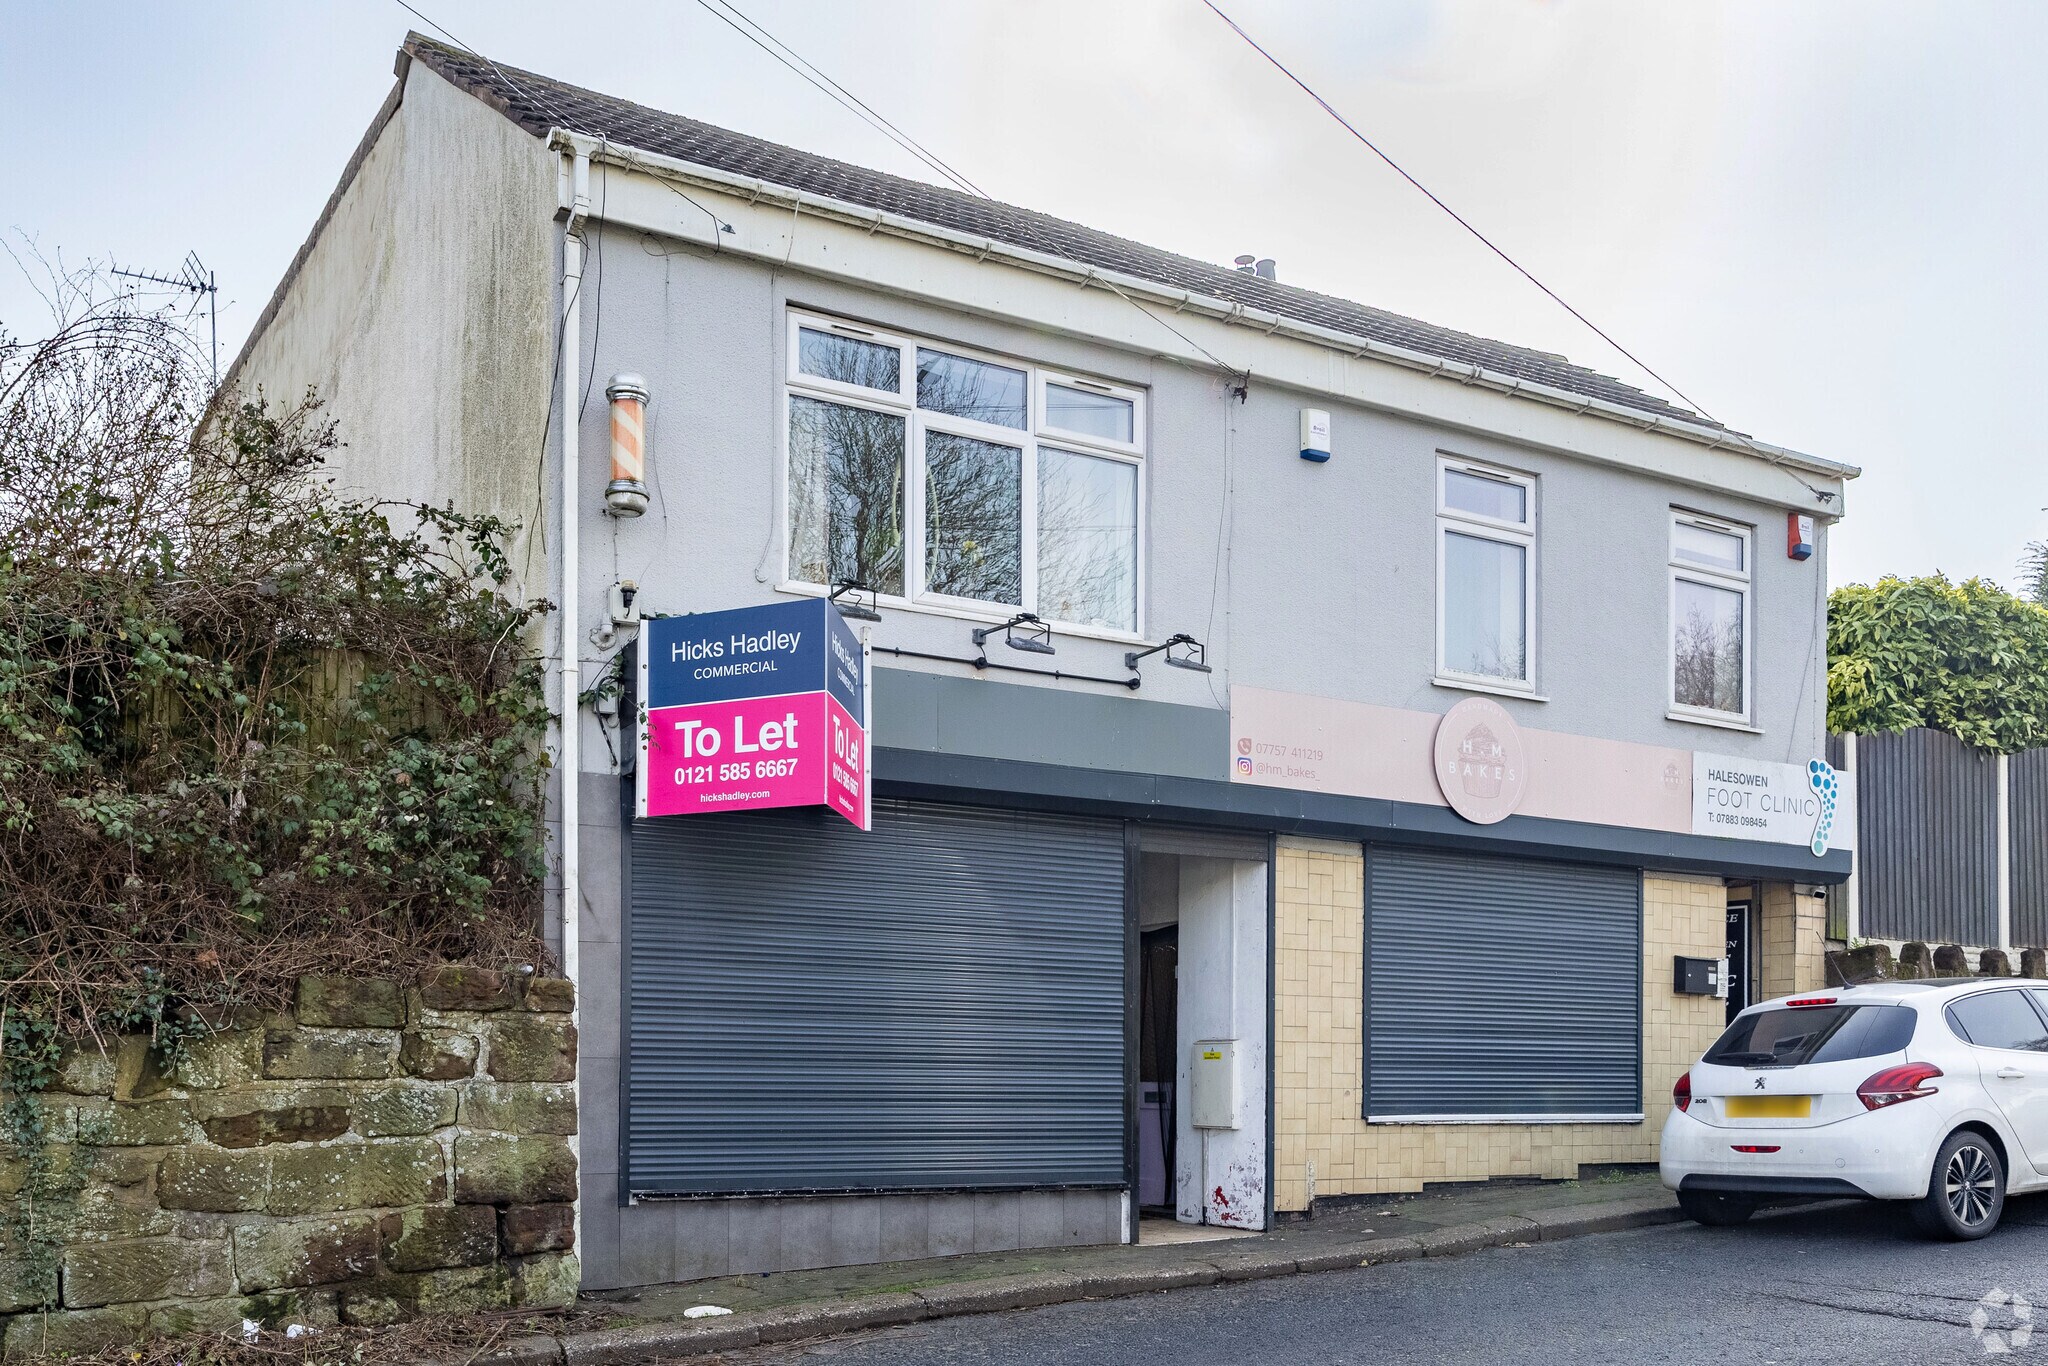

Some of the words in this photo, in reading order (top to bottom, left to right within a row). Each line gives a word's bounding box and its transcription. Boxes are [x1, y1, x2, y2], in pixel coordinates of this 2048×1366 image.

[672, 637, 724, 663] Hicks
[731, 630, 801, 655] Hadley
[832, 631, 845, 664] Hicks
[693, 660, 778, 680] COMMERCIAL
[675, 720, 722, 758] To
[735, 712, 799, 754] Let
[832, 714, 844, 758] To
[846, 727, 859, 774] Let
[1255, 743, 1287, 756] 07757
[1291, 747, 1324, 761] 411219
[674, 765, 713, 785] 0121
[719, 762, 751, 781] 585
[755, 758, 799, 779] 6667
[1448, 761, 1516, 782] BAKES
[1708, 769, 1768, 788] HALESOWEN
[700, 790, 771, 803] hickshadley.com
[1707, 787, 1752, 810] FOOT
[1760, 794, 1815, 817] CLINIC
[1708, 812, 1715, 822] T:
[1716, 813, 1739, 825] 07883
[1740, 816, 1767, 828] 098454
